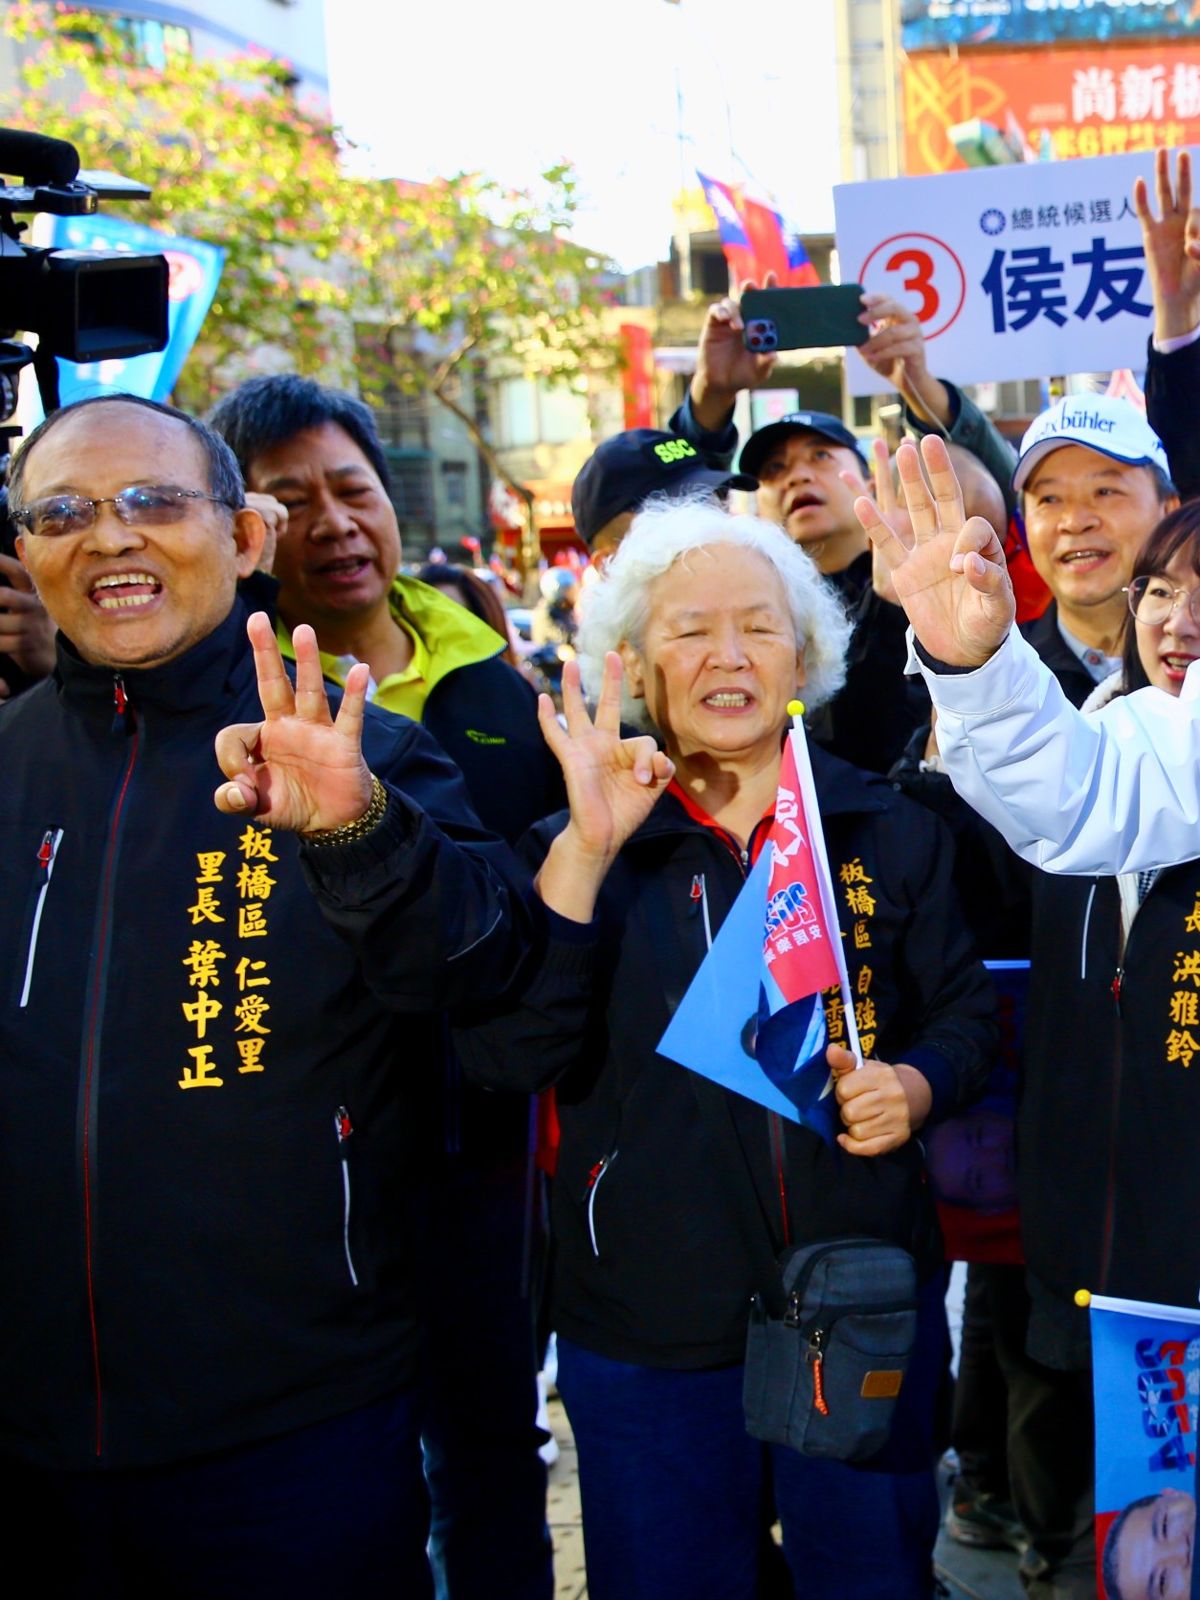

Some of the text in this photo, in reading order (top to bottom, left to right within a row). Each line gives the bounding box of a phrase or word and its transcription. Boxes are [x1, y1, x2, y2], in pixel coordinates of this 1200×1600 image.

[1011, 197, 1137, 232] 總統候選人
[885, 249, 941, 324] 3
[653, 438, 697, 464] SSC
[1060, 402, 1118, 434] bühler
[839, 857, 877, 950] 板橋區
[178, 851, 226, 1089] 里長 葉中正
[234, 825, 279, 1074] 板橋區 仁愛里
